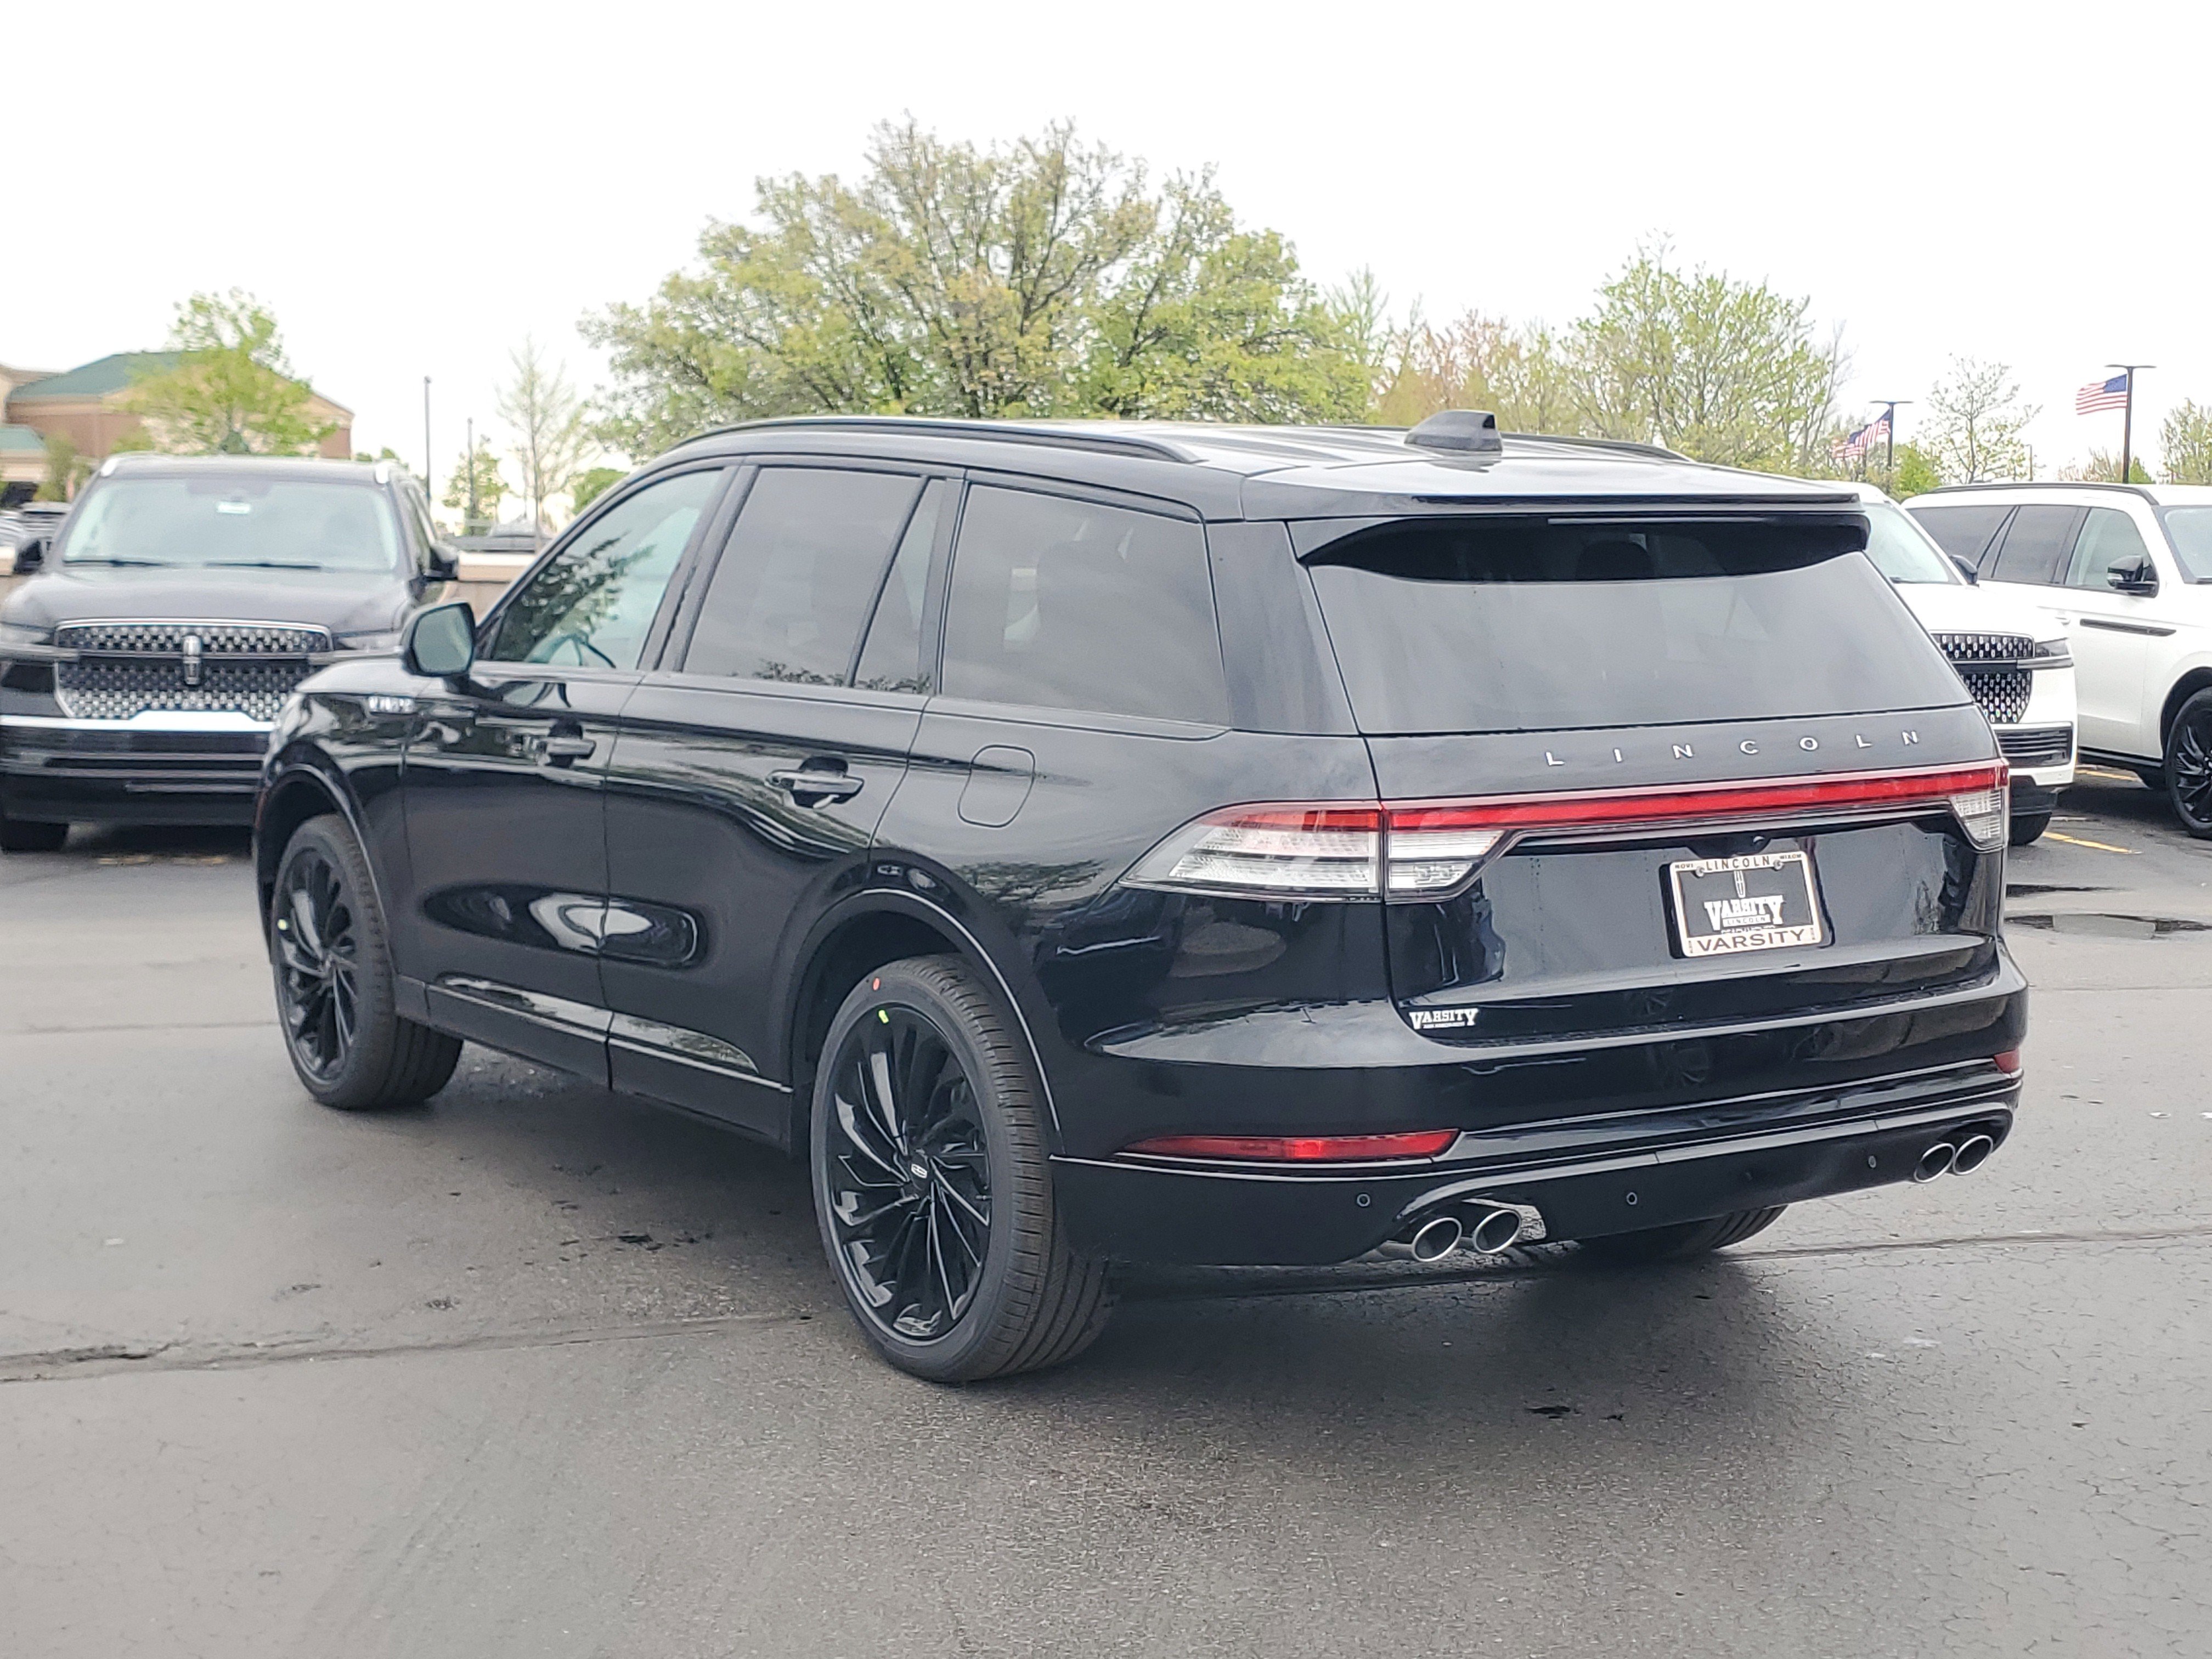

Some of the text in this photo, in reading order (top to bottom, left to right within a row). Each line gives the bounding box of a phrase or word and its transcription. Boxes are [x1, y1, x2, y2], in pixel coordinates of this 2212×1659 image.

[1546, 730, 1920, 766] LINCOLN
[1706, 855, 1770, 871] LINCOLN
[1704, 895, 1784, 931] VARSITY
[1726, 917, 1766, 926] LINCOLN
[1697, 929, 1804, 952] VARSITY
[1409, 1008, 1479, 1030] VARSITY
